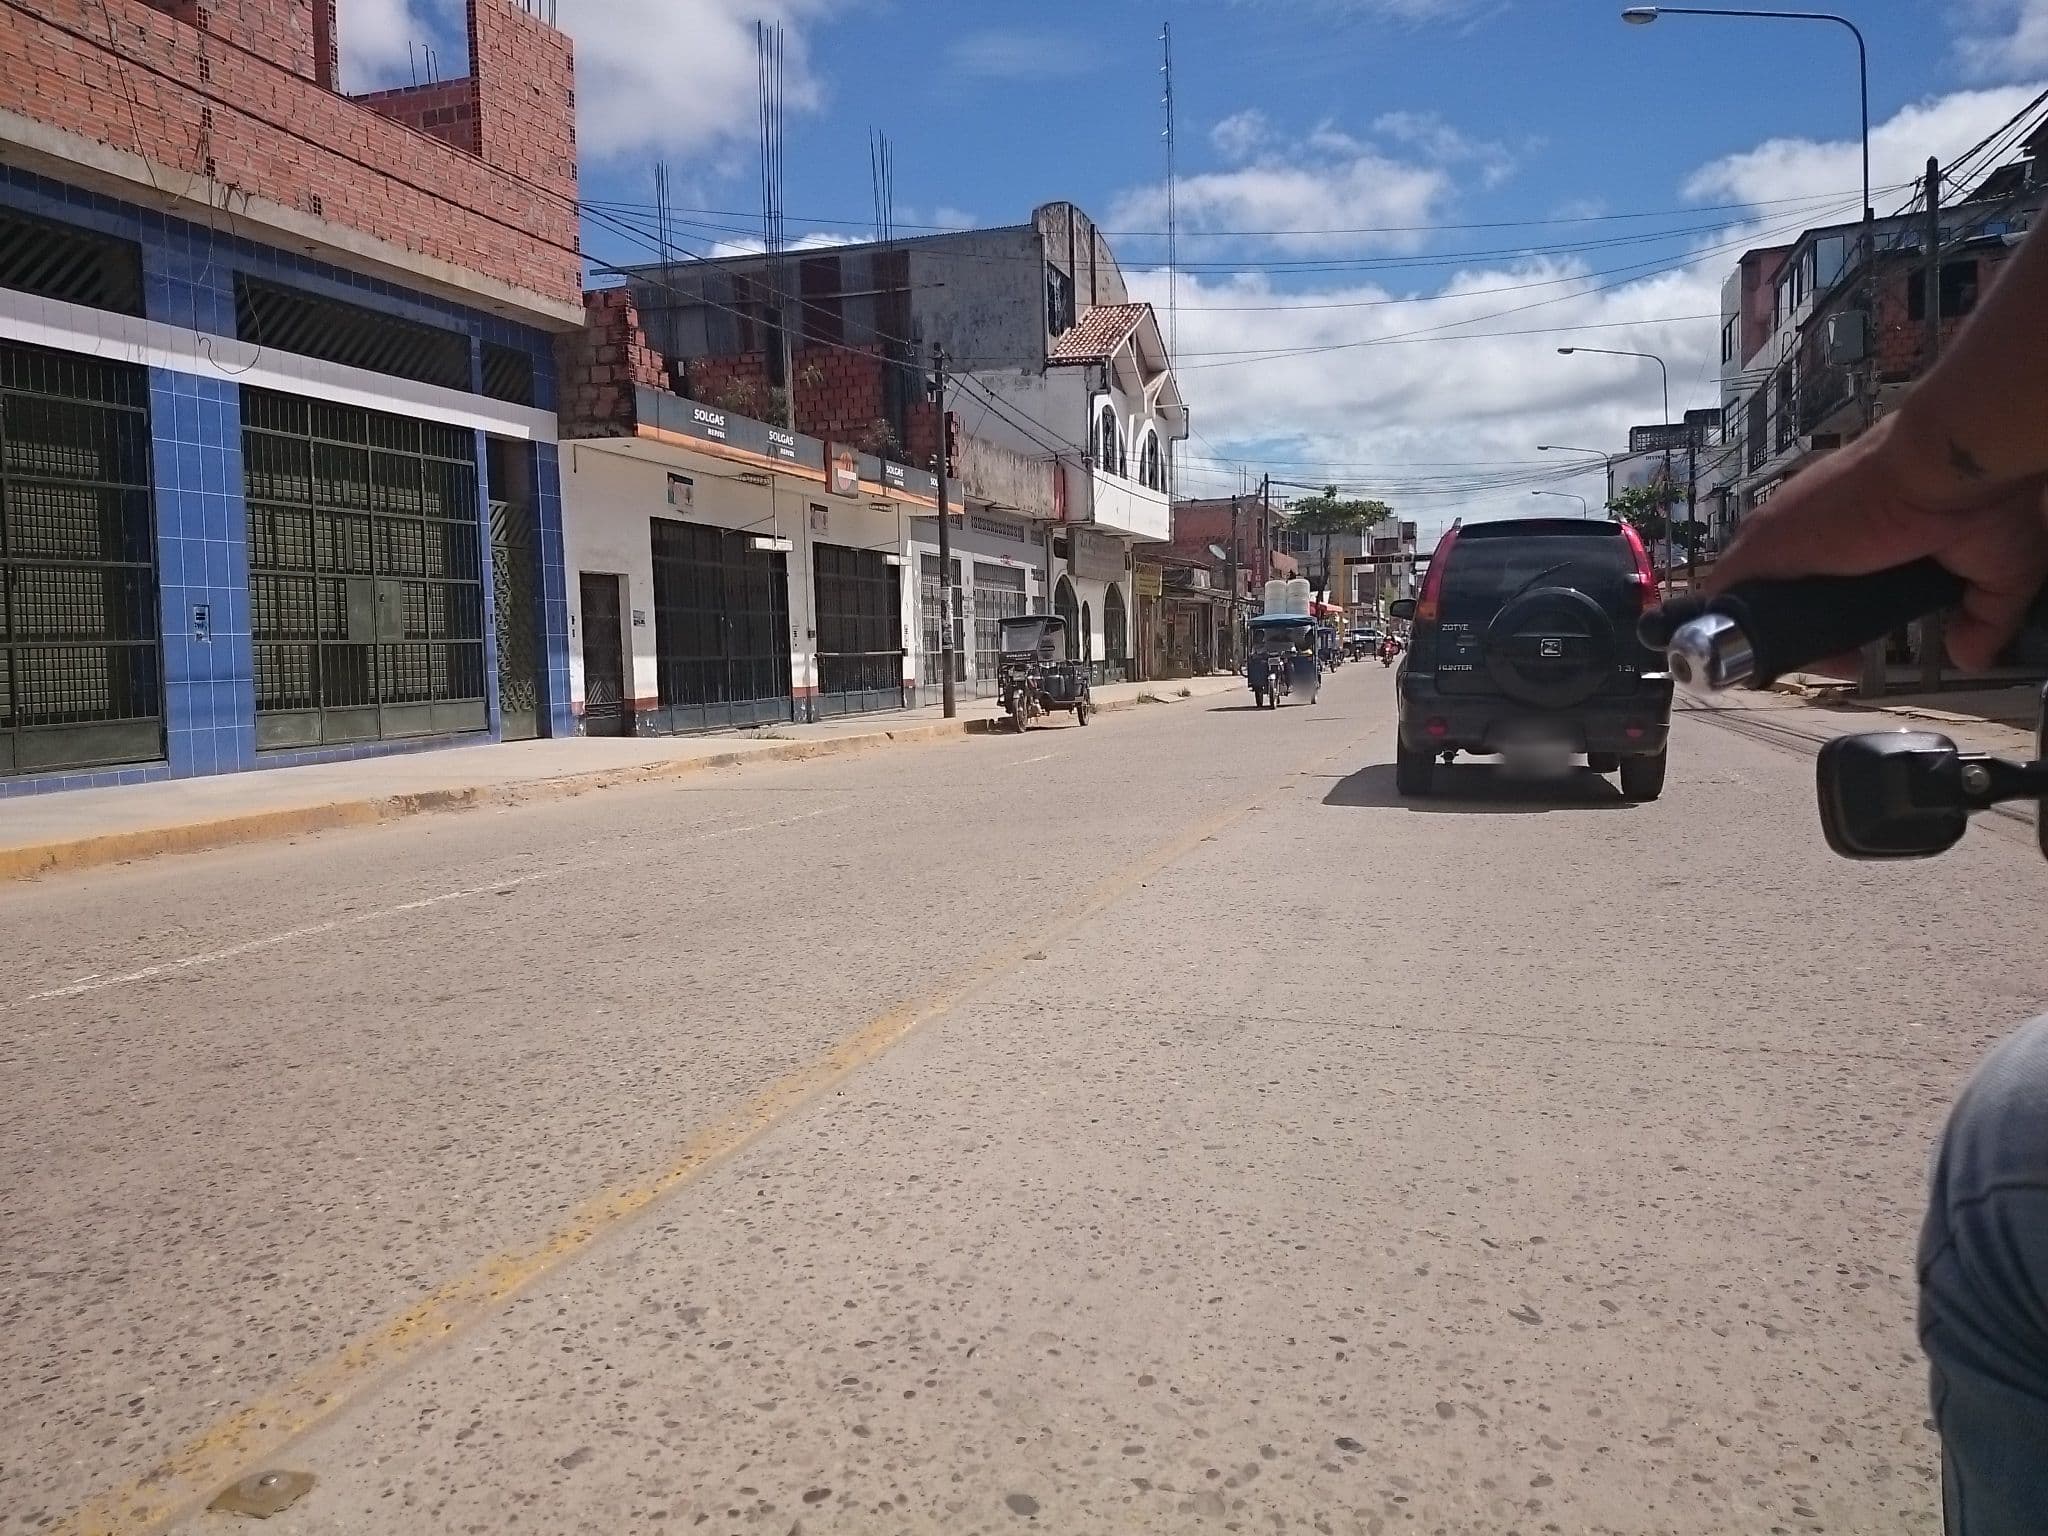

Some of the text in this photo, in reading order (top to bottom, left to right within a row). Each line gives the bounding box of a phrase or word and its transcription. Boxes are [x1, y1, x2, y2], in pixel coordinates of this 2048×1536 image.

[694, 408, 725, 426] SOLGAS
[768, 430, 794, 446] SOLGAS
[1441, 623, 1469, 631] ZOTYE
